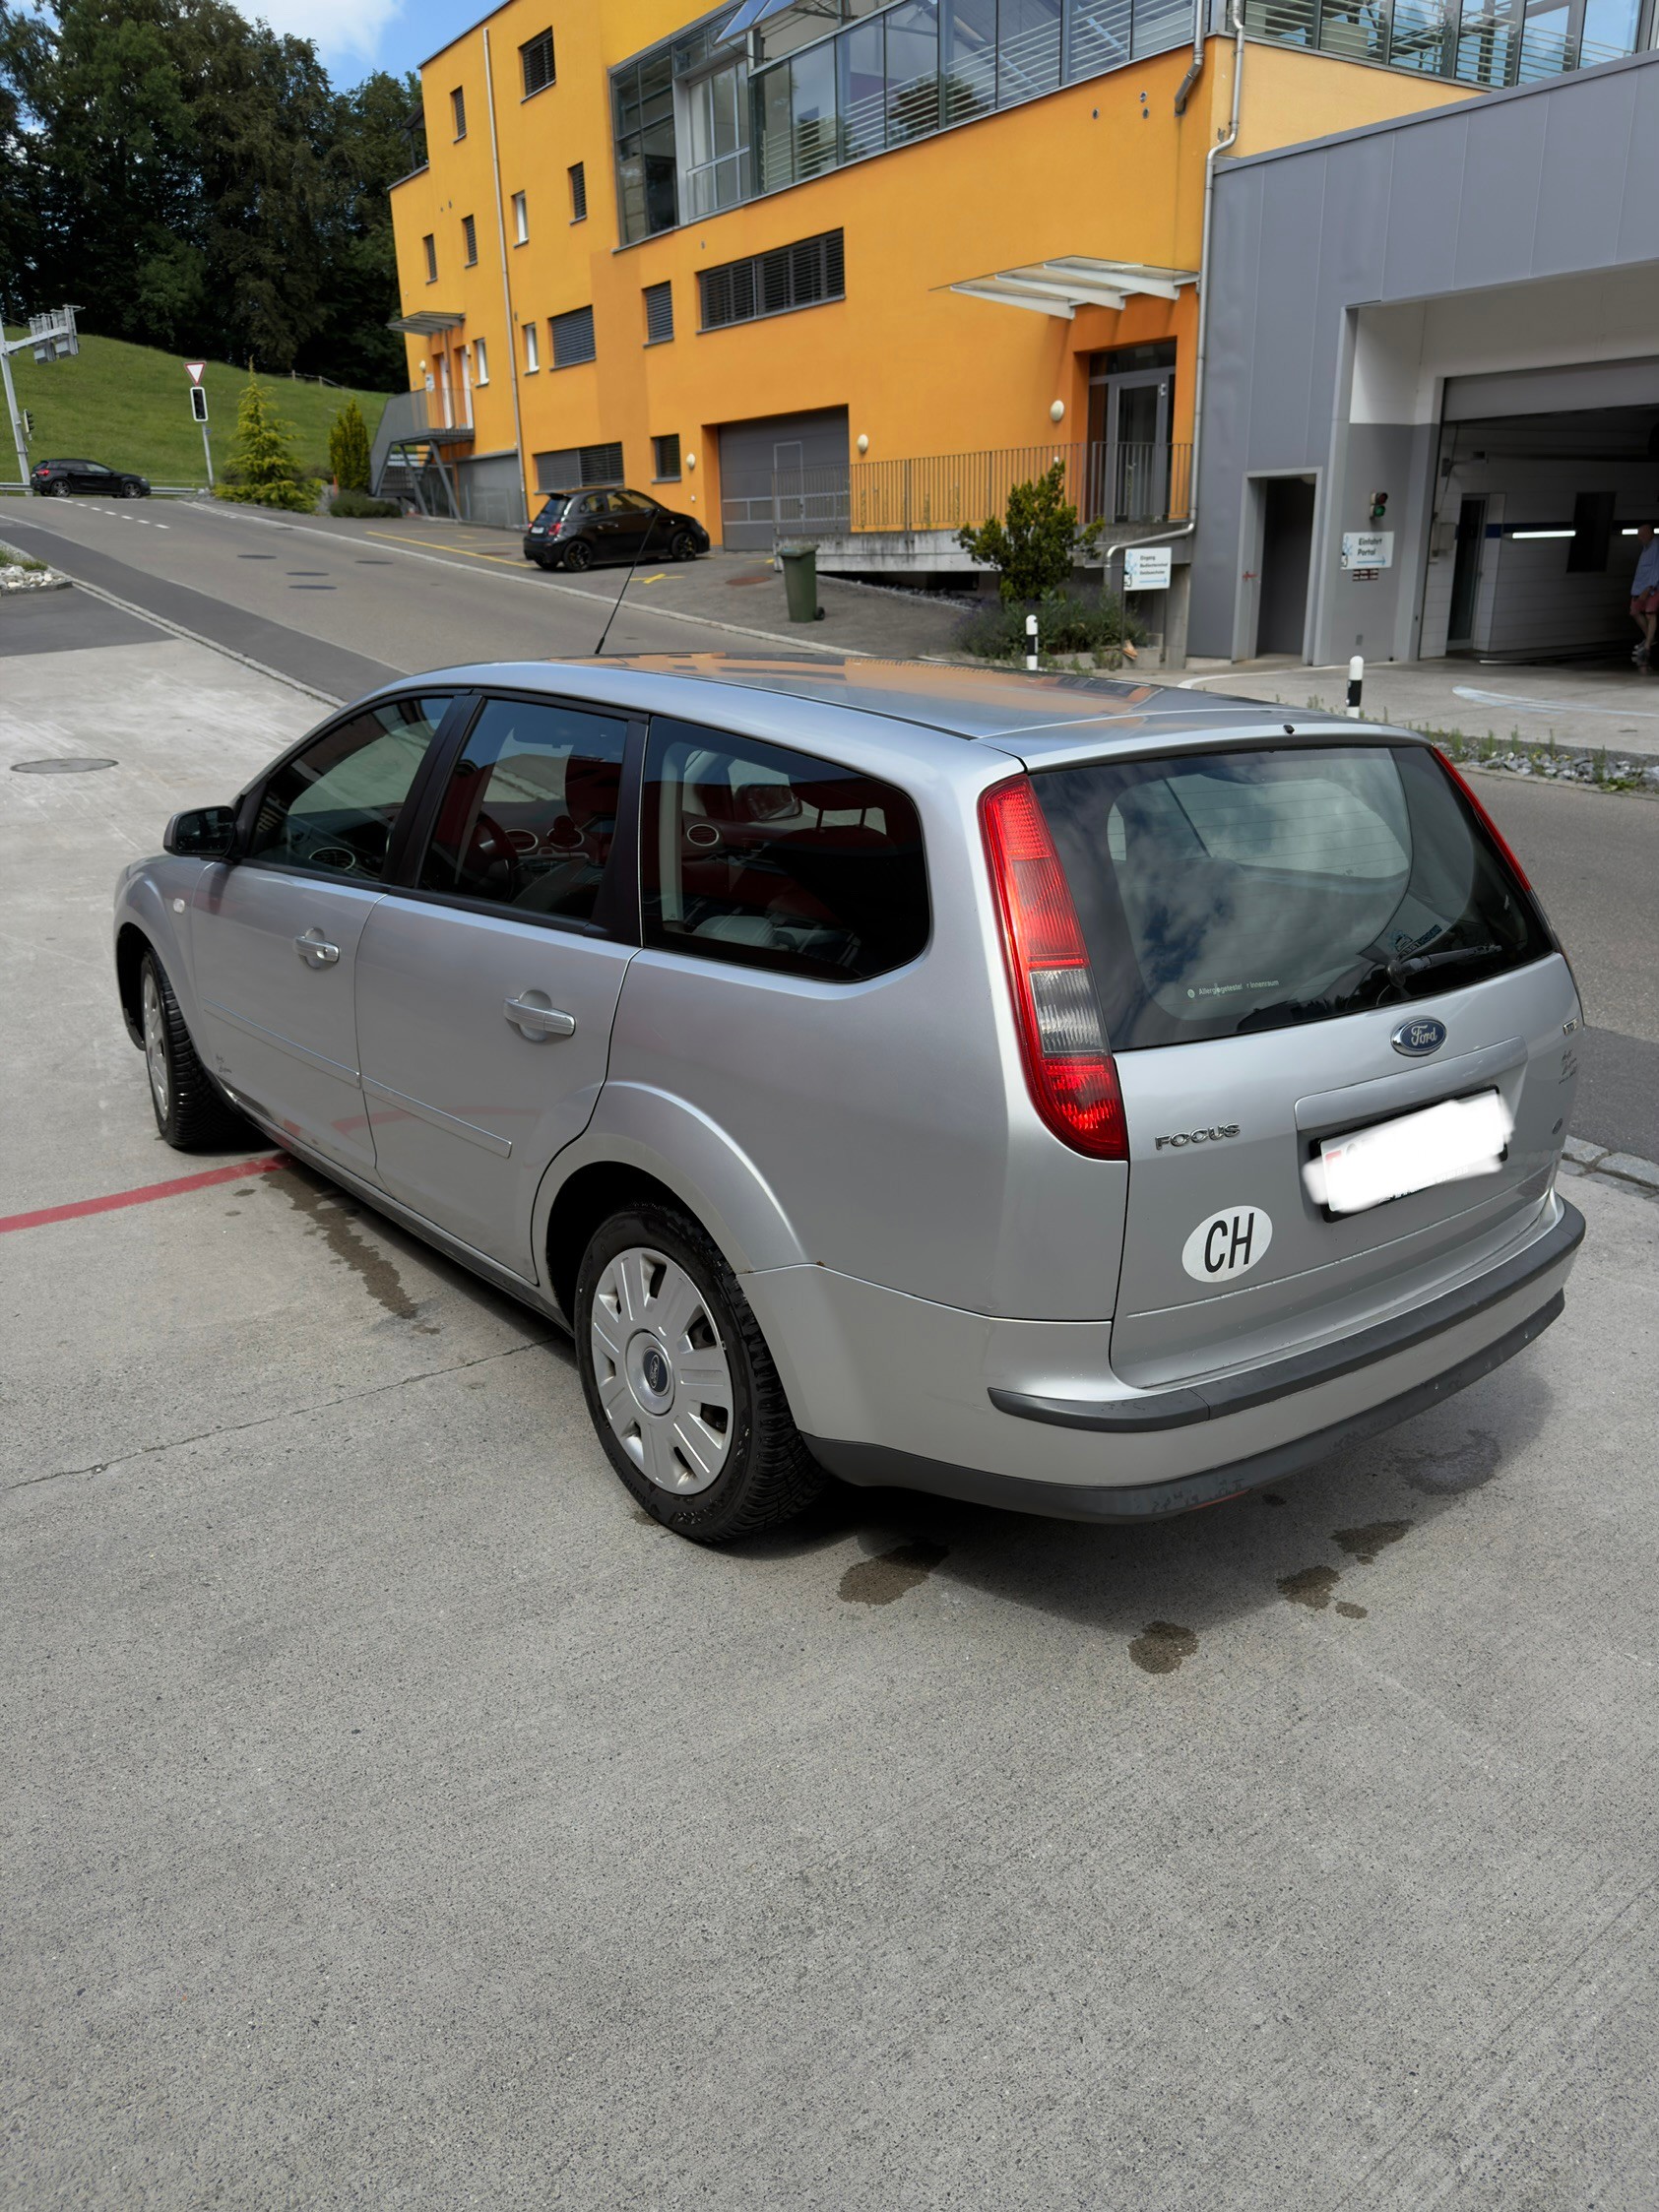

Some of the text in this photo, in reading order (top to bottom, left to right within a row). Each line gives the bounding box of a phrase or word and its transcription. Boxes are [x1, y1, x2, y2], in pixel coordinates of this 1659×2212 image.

[1411, 1024, 1437, 1046] Ford
[1155, 1123, 1241, 1151] FOCUS
[1204, 1212, 1255, 1273] CH
